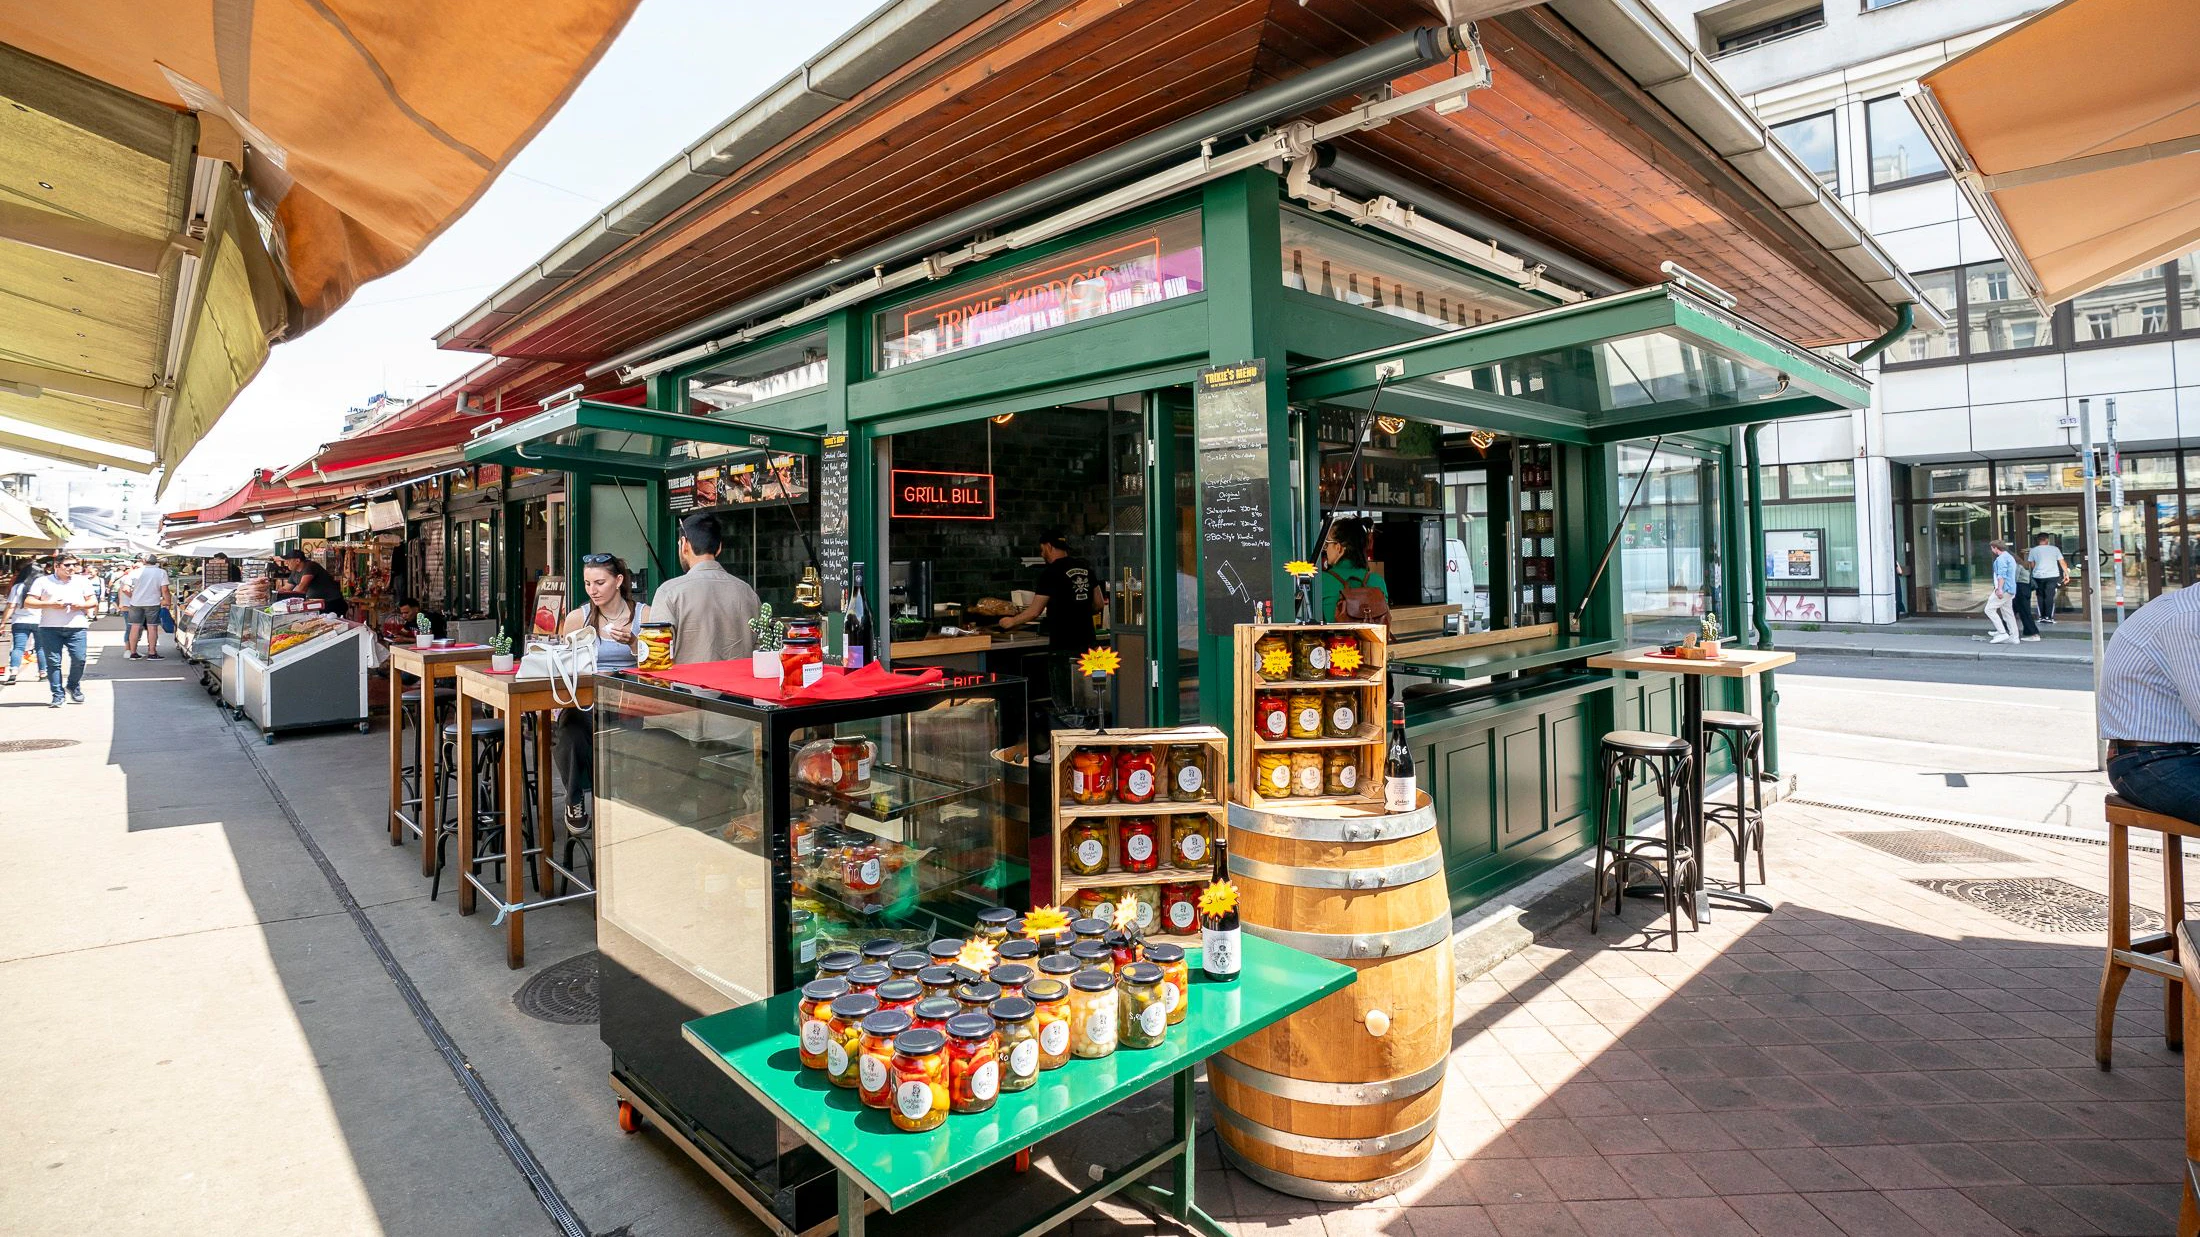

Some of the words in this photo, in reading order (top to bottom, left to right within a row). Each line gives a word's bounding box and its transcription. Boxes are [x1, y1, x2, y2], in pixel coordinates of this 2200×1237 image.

[1205, 368, 1235, 385] TRIXIE'S
[1236, 366, 1258, 379] MENU
[904, 486, 948, 504] GRILL
[951, 488, 983, 504] BILL
